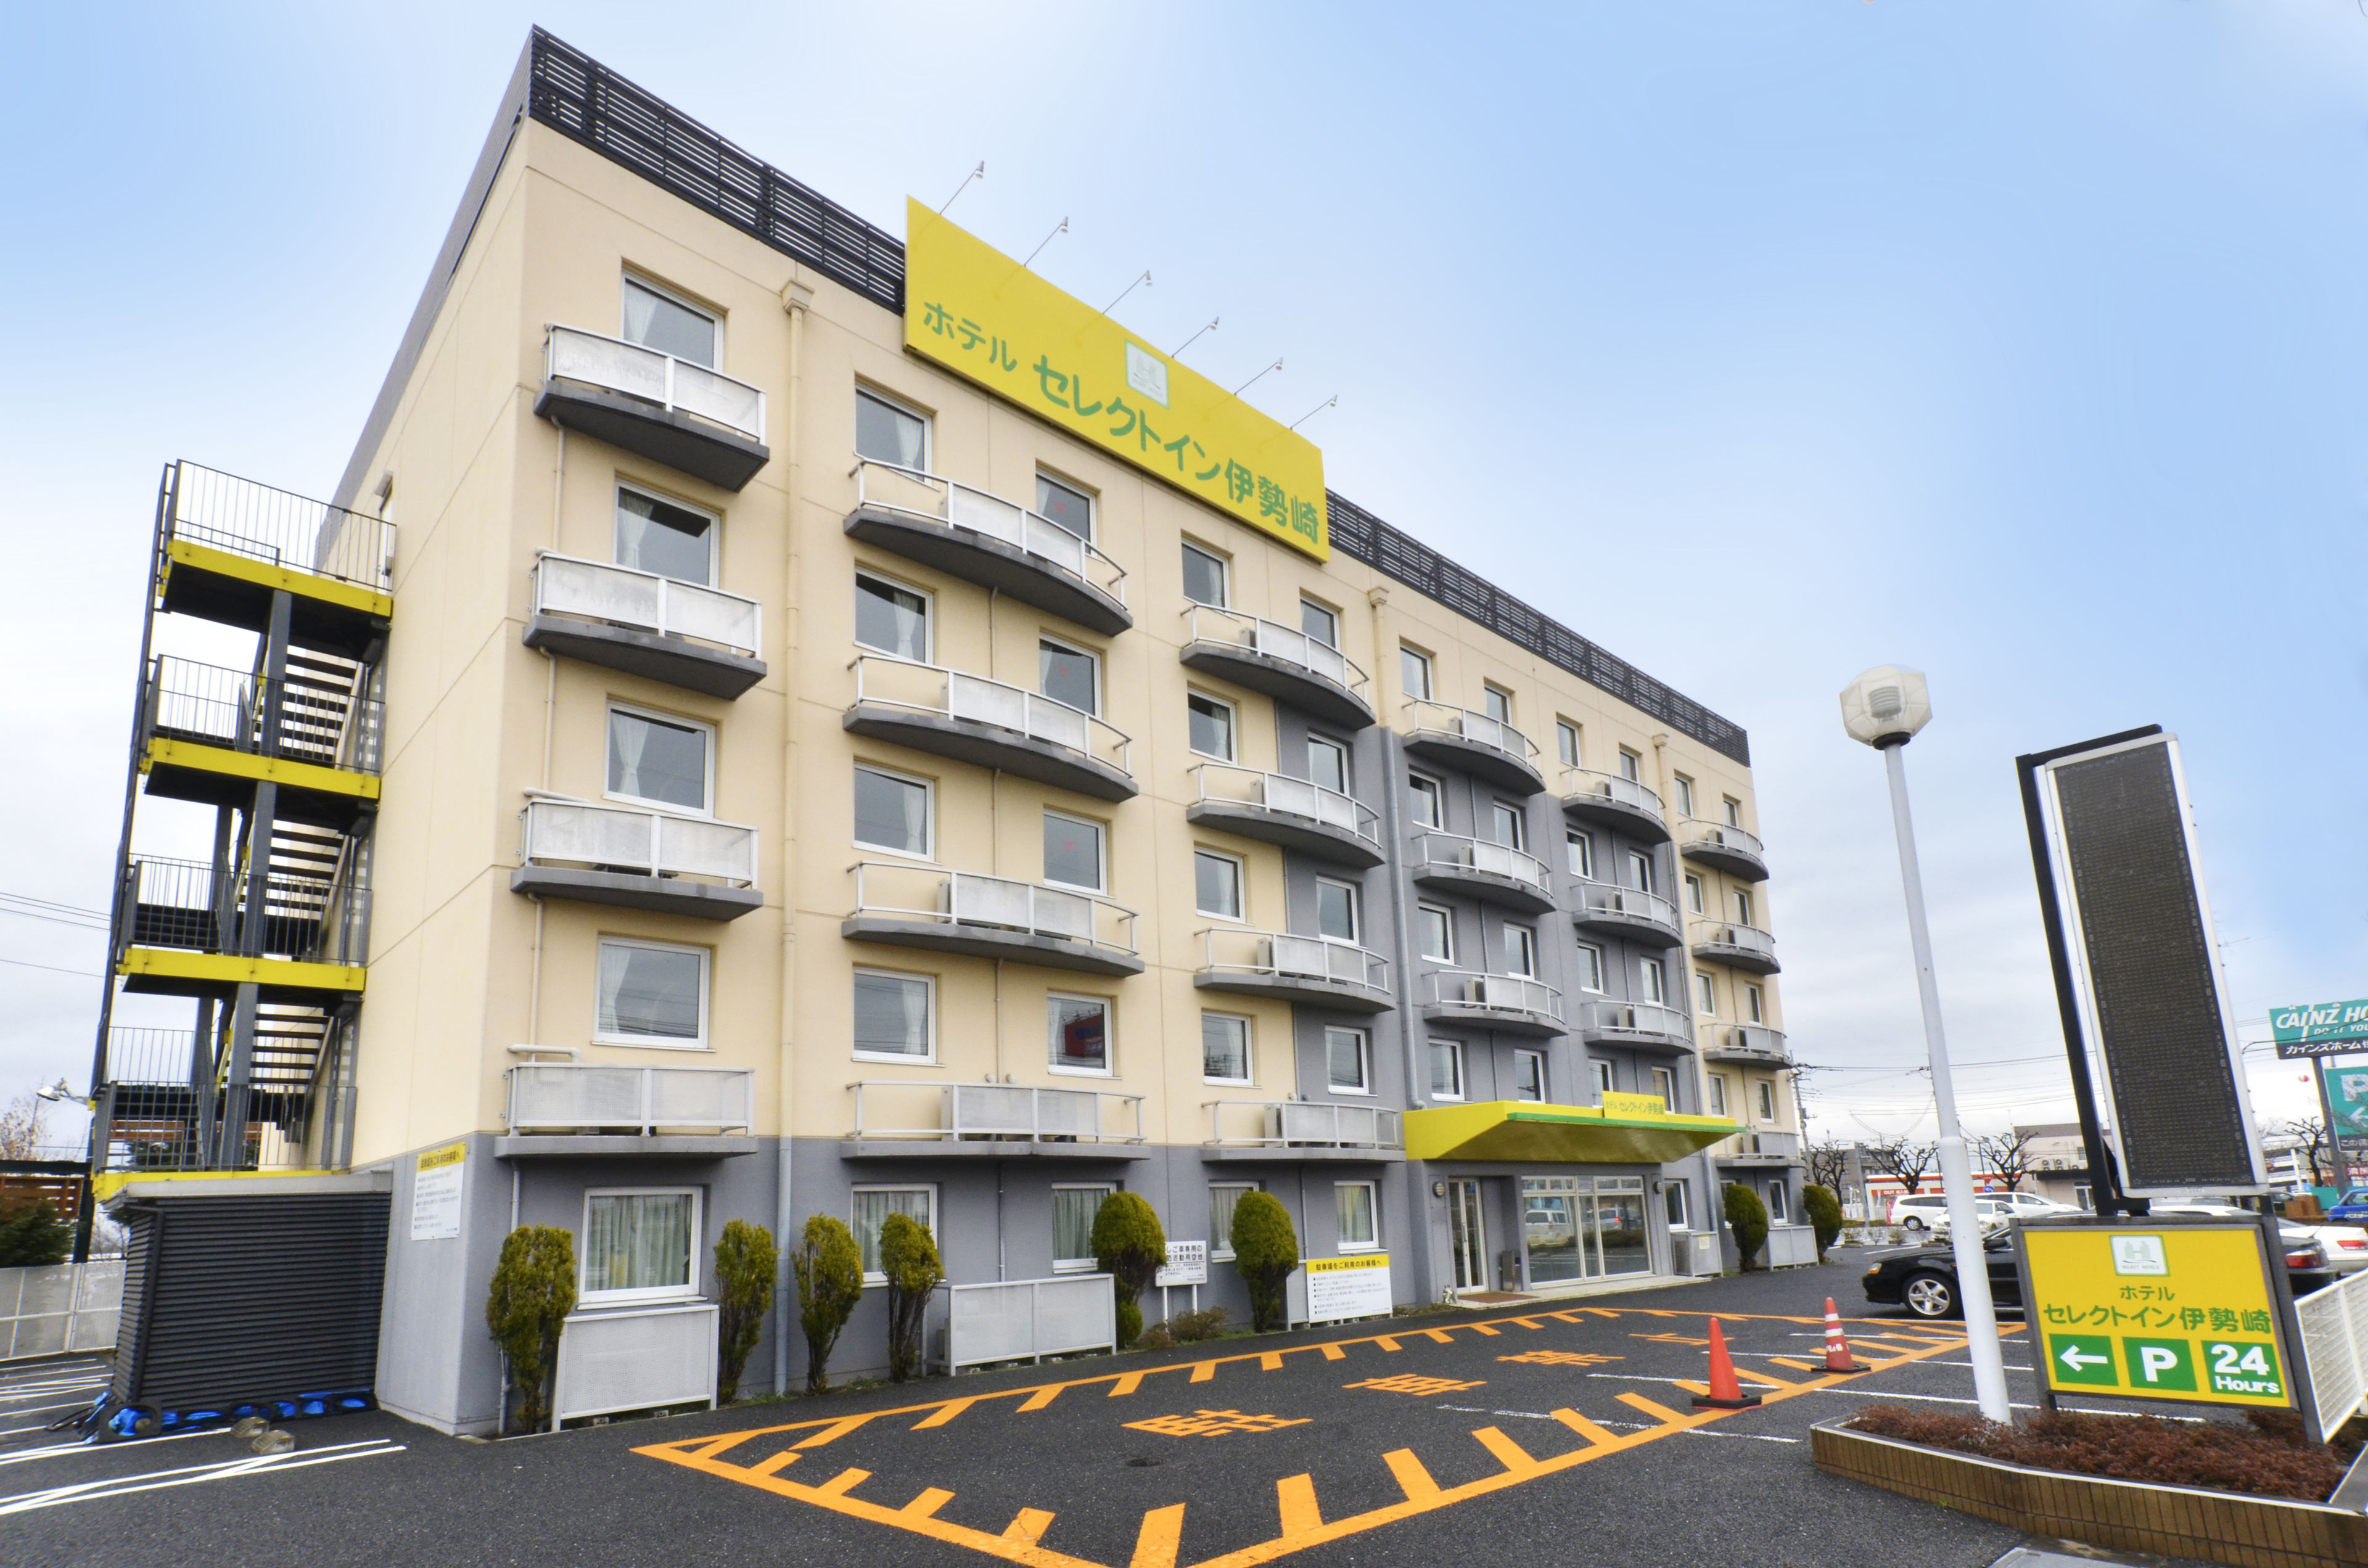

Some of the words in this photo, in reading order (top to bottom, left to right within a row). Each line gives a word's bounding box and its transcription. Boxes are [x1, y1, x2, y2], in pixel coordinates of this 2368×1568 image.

[923, 301, 1018, 372] ホテル
[1032, 353, 1320, 544] セレクトイン伊勢崎
[2276, 1009, 2340, 1029] CAINZ
[2340, 1073, 2368, 1102] P
[2119, 1285, 2176, 1302] ホテル
[2043, 1303, 2272, 1334] セレクトイン伊勢崎
[2140, 1346, 2178, 1382] P
[2210, 1343, 2271, 1376] 24
[2215, 1374, 2281, 1394] Hours
